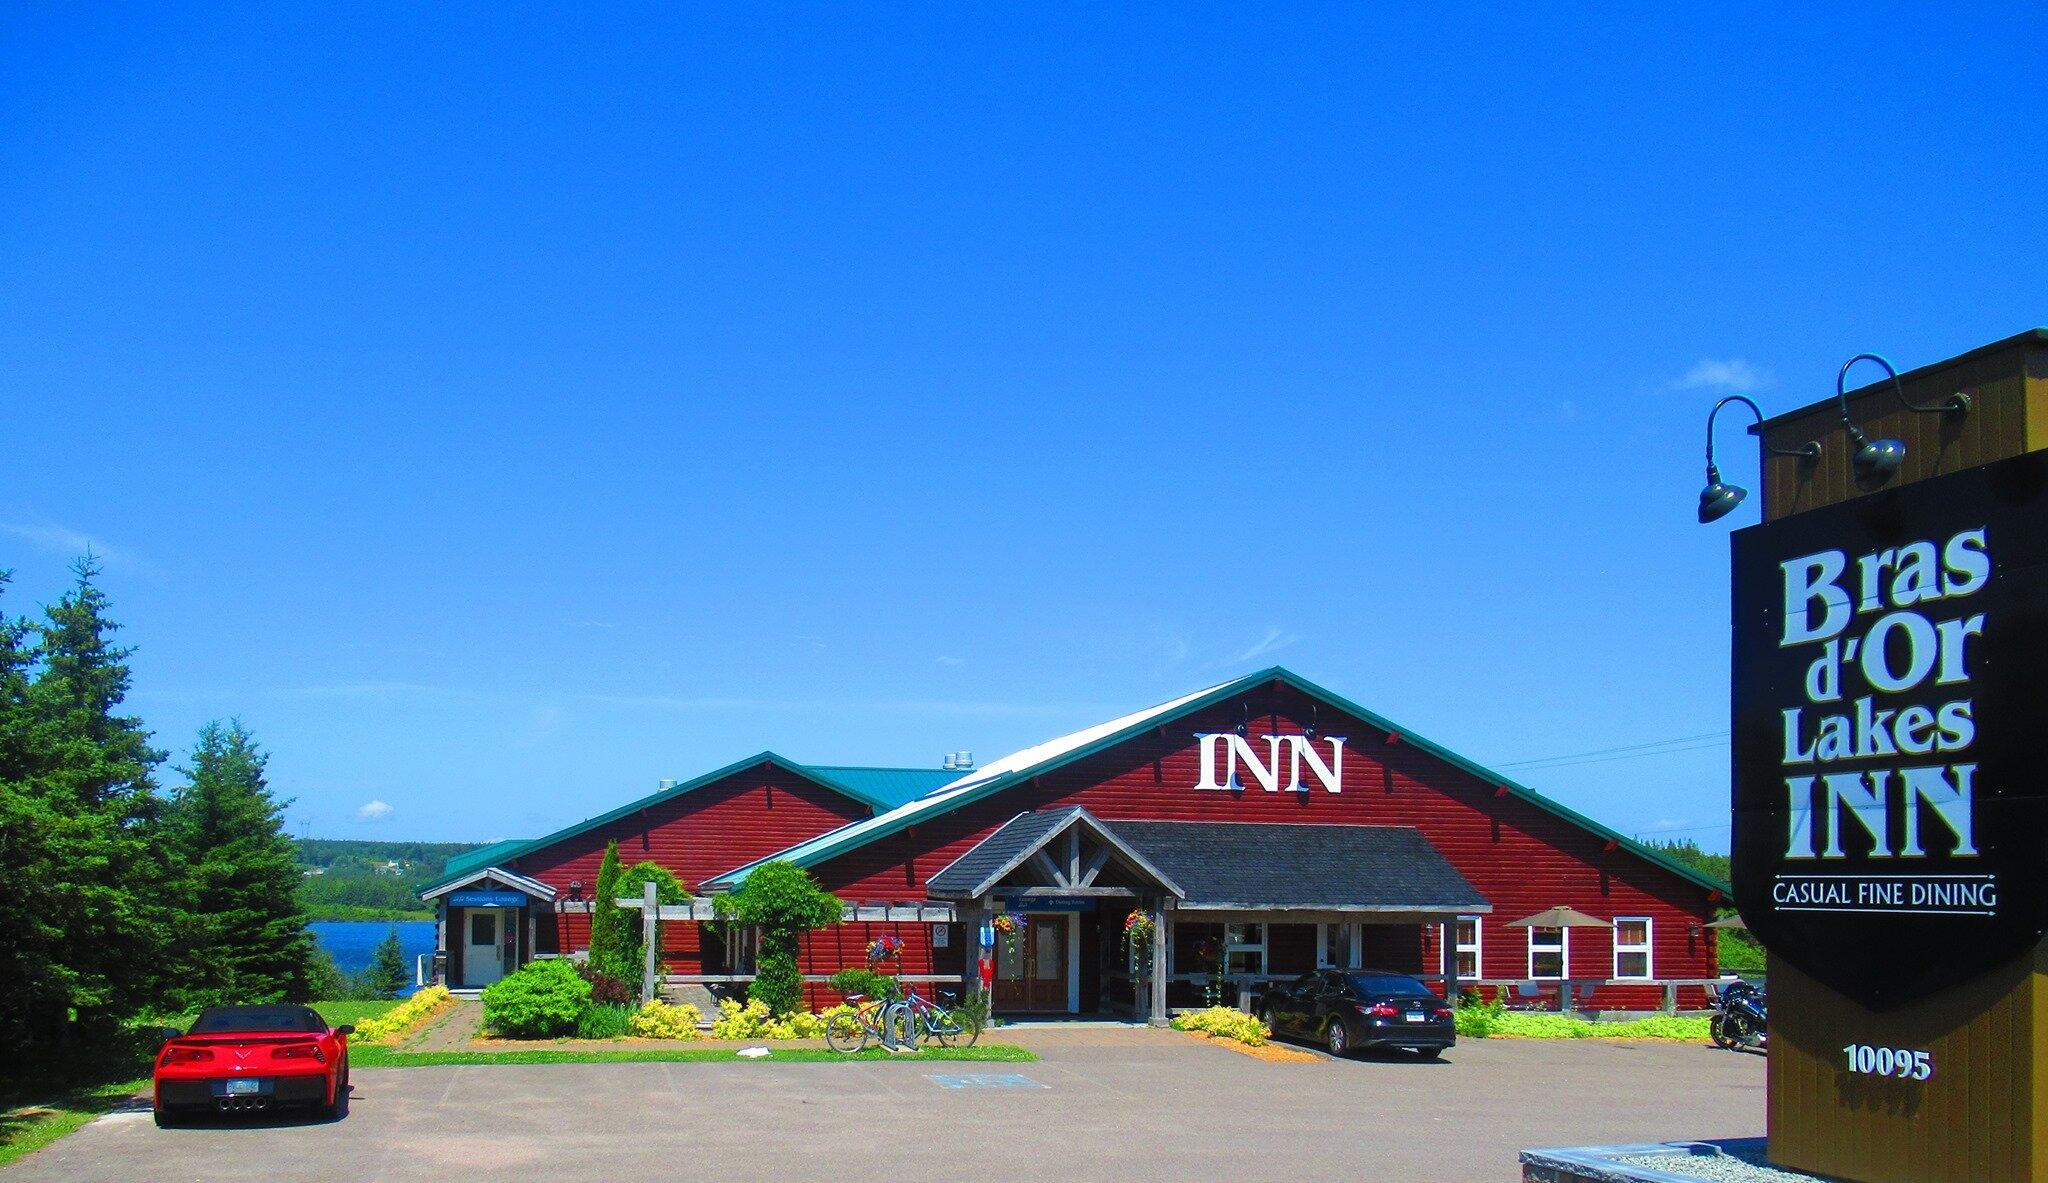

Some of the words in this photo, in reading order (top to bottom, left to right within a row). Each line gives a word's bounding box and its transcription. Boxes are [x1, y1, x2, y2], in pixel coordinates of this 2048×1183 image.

[1779, 526, 1991, 648] Bras
[1806, 612, 1987, 702] d'Or
[1193, 732, 1347, 793] INN
[1782, 697, 1976, 765] Lakes
[1785, 763, 1980, 860] INN
[1773, 882, 1851, 903] CASUAL
[1858, 883, 1904, 905] FINE
[1911, 883, 1997, 907] DINING
[1843, 1044, 1931, 1081] 10095
